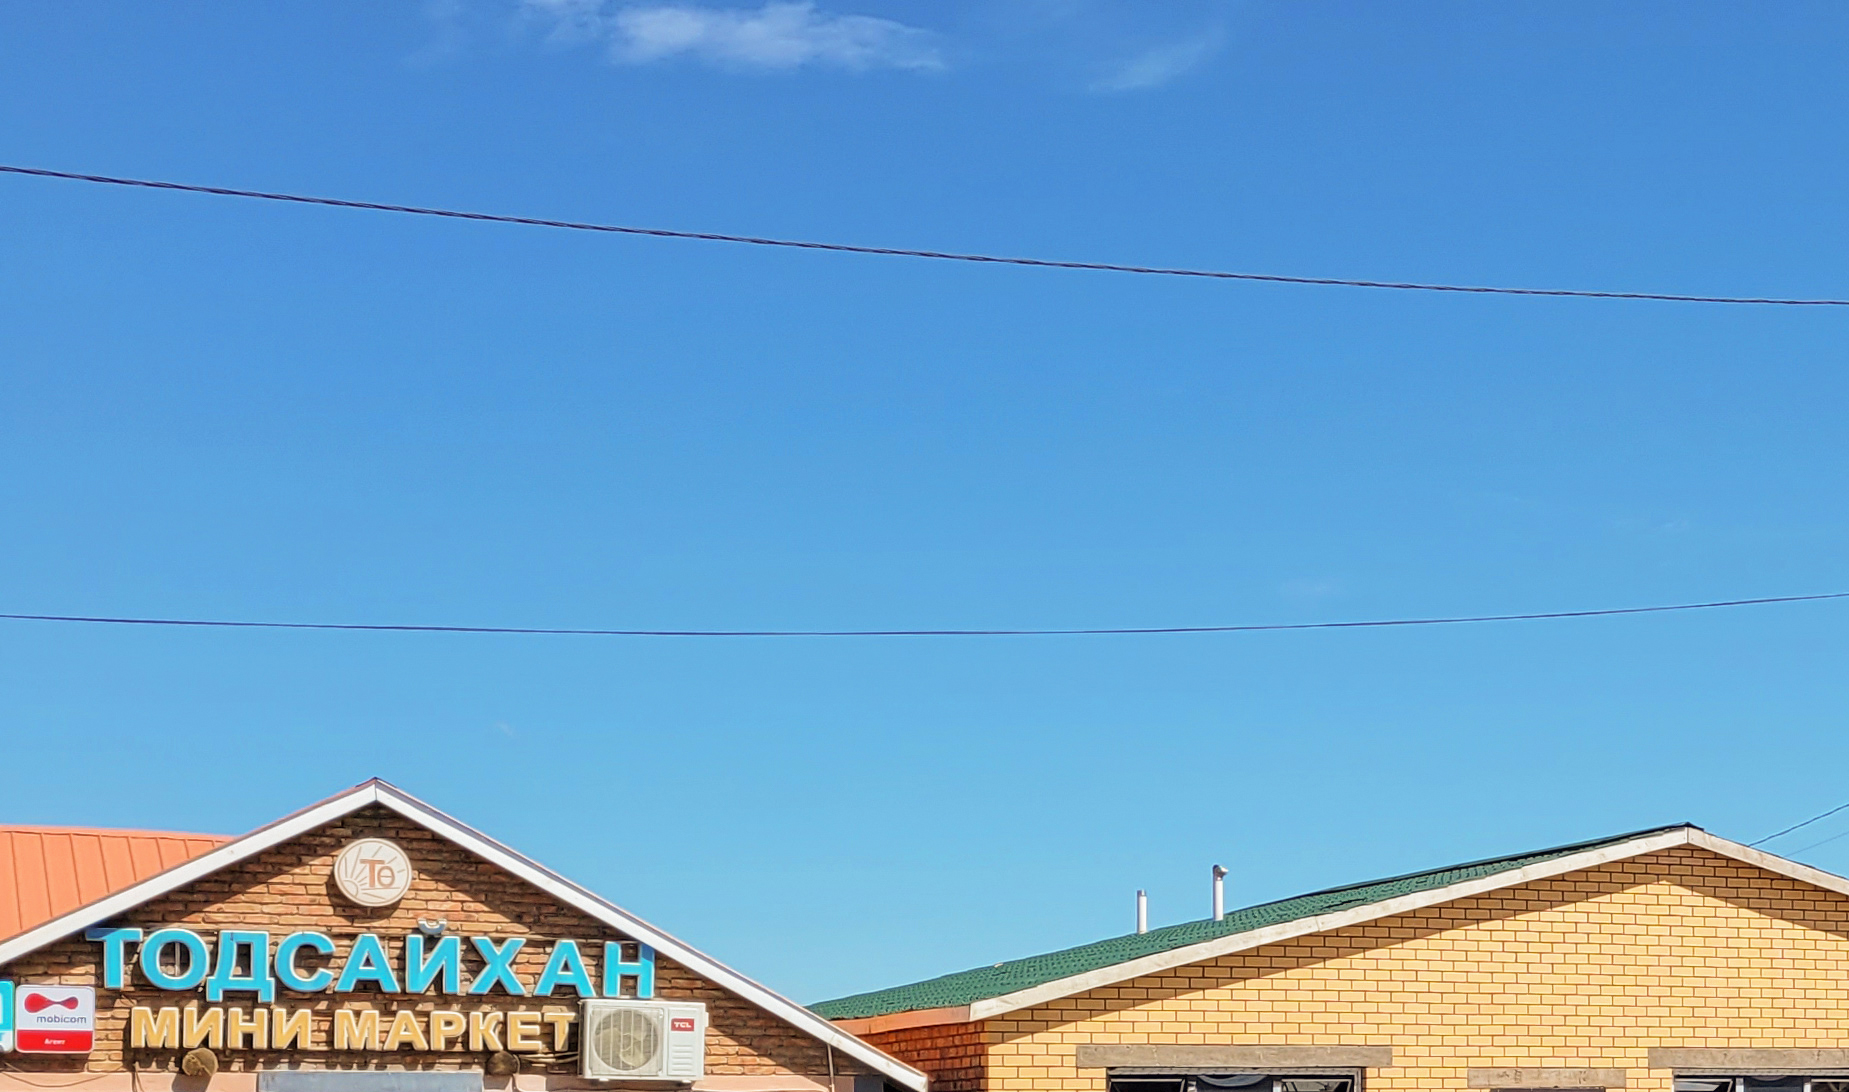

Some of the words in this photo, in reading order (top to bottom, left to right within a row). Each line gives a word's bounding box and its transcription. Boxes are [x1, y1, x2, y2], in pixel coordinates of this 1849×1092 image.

[85, 918, 655, 1002] ТОДСАЙХАН
[36, 1014, 87, 1023] mobicom
[131, 1006, 312, 1049] МИНИ
[334, 1009, 577, 1051] МАРКЕТ
